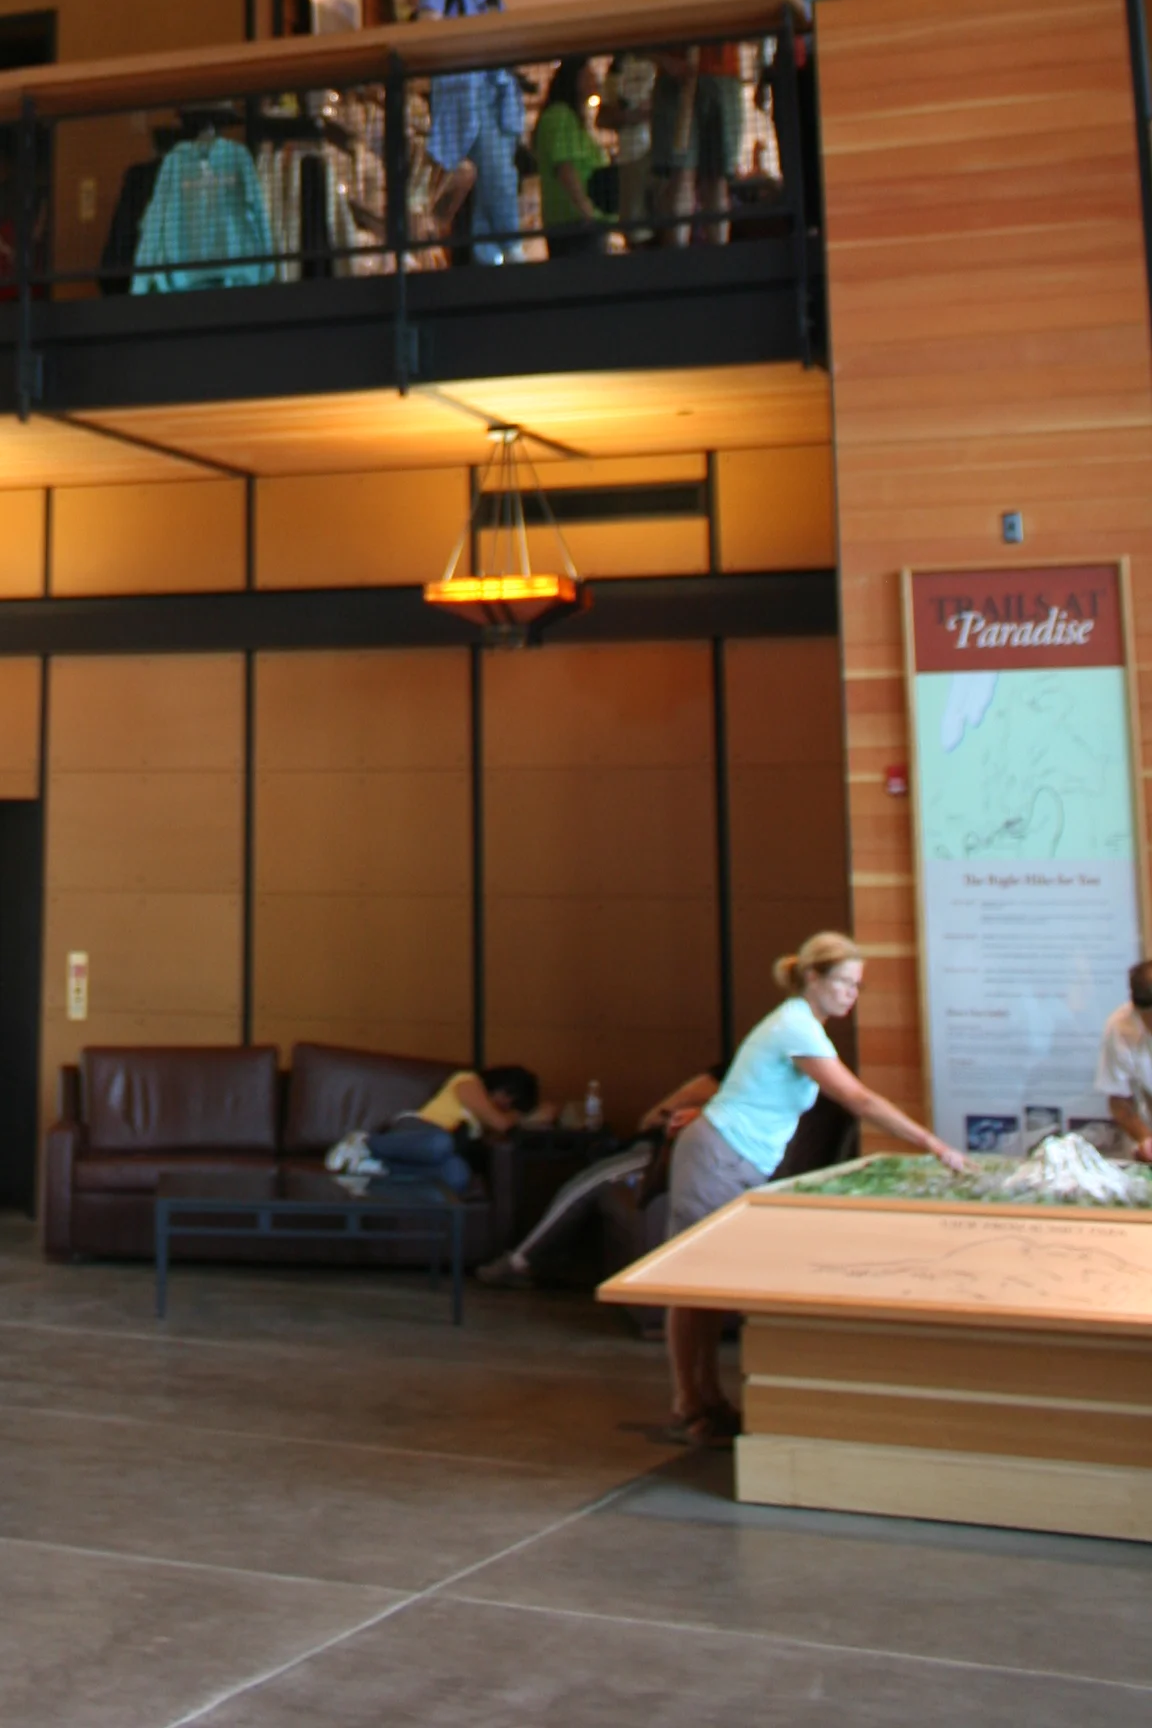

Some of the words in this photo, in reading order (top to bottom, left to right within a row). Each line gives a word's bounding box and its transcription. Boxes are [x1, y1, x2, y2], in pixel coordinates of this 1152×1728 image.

[929, 592, 1052, 625] TRAILS
[1064, 587, 1108, 618] AT
[945, 606, 1095, 649] Paradise
